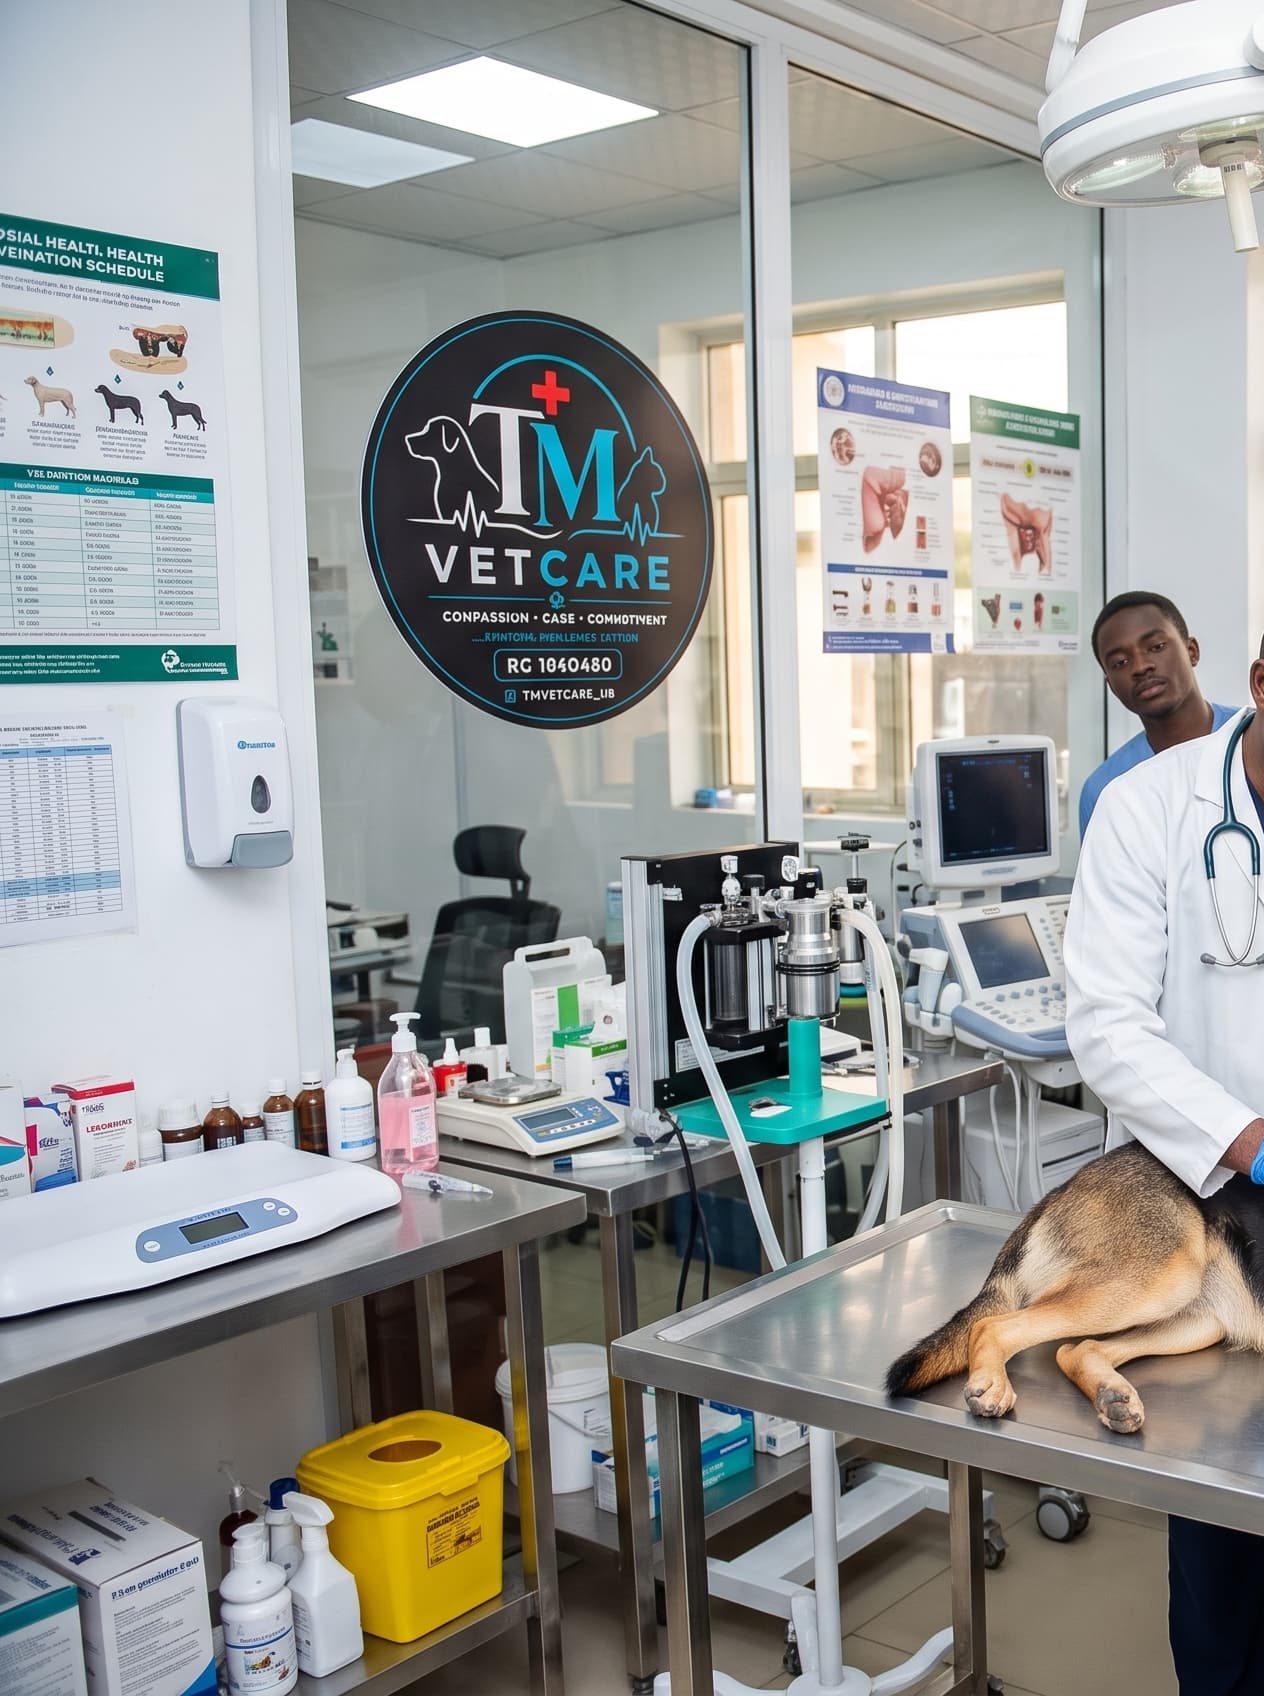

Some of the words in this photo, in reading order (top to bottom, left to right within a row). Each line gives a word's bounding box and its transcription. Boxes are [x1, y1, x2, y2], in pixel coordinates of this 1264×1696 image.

[106, 246, 164, 267] HEALTH
[86, 259, 165, 283] SCHEDULE
[469, 403, 621, 527] TM
[425, 544, 671, 591] VETCARE
[542, 612, 575, 624] CASE
